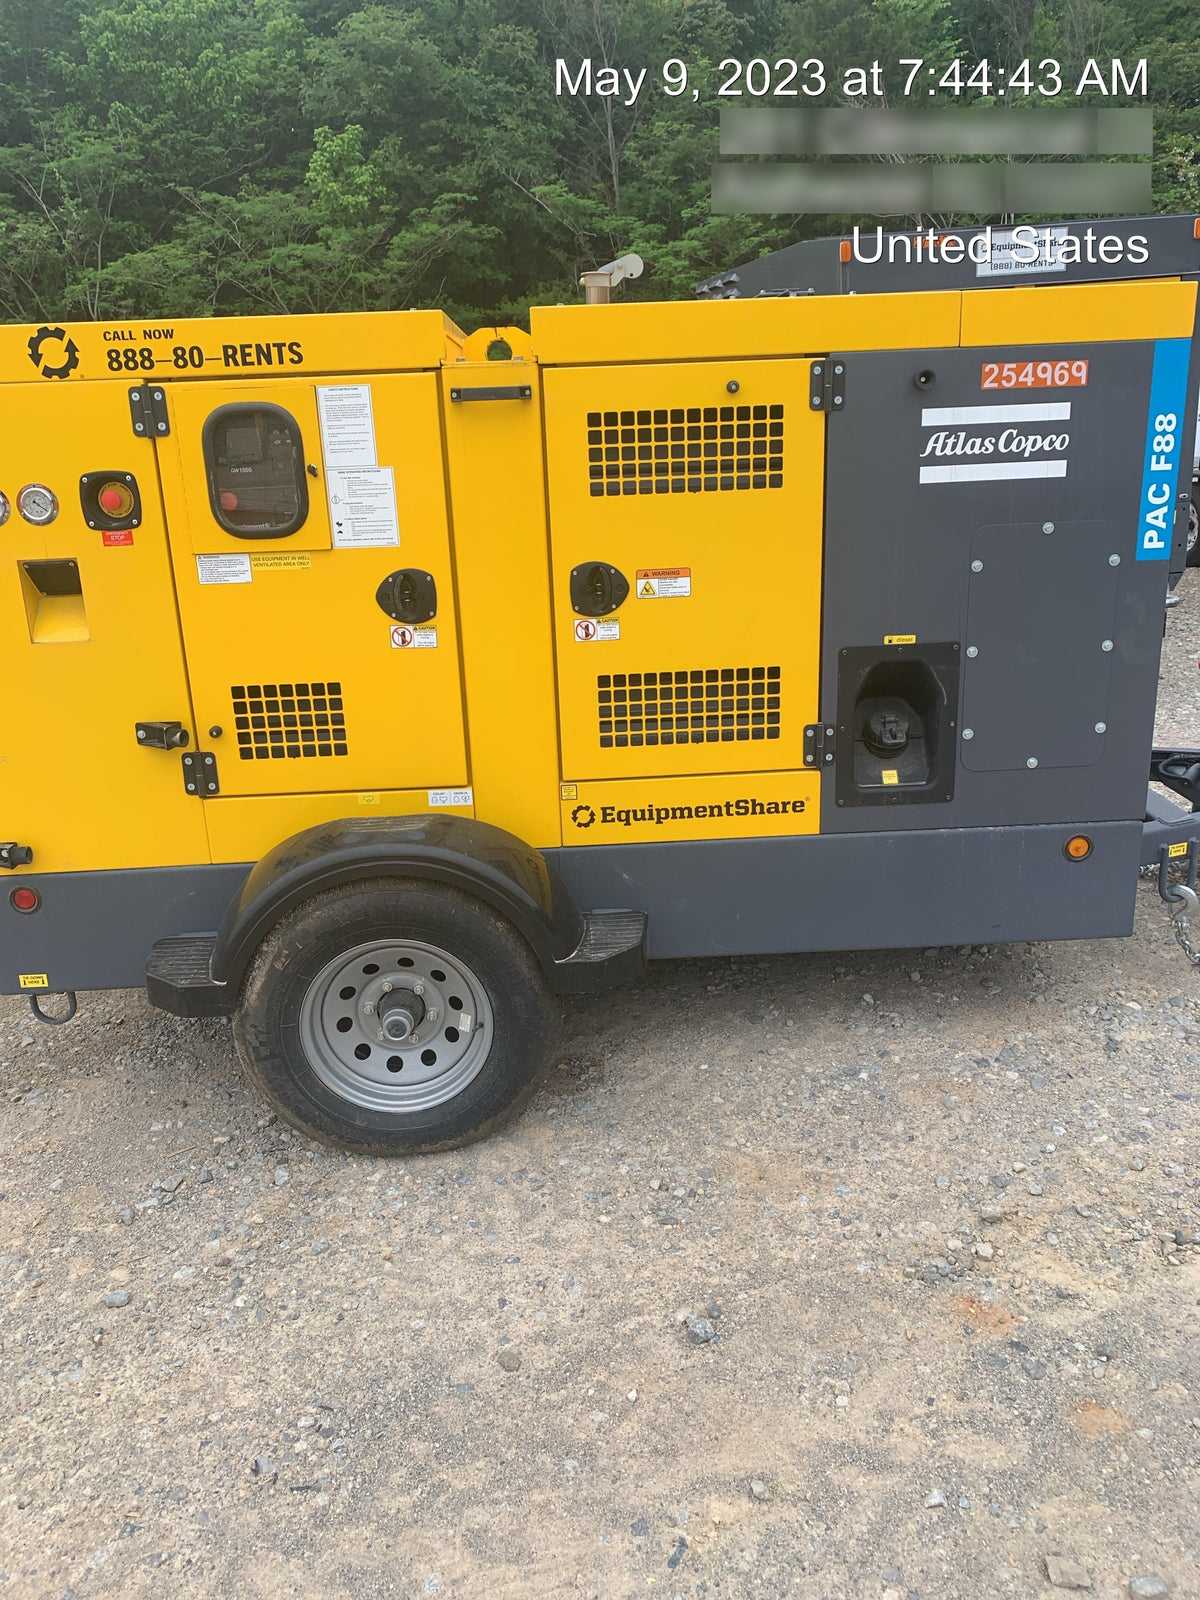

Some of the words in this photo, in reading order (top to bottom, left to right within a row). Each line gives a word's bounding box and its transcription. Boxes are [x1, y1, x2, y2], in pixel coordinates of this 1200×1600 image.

[102, 329, 137, 342] CALL
[143, 328, 175, 340] NOW
[982, 360, 1088, 389] 254969
[919, 431, 996, 457] Atlas
[997, 428, 1070, 458] Copco
[1150, 412, 1177, 472] F88
[1143, 483, 1171, 550] PAC
[651, 569, 681, 577] WARNING
[600, 798, 806, 826] EquipmentShare
